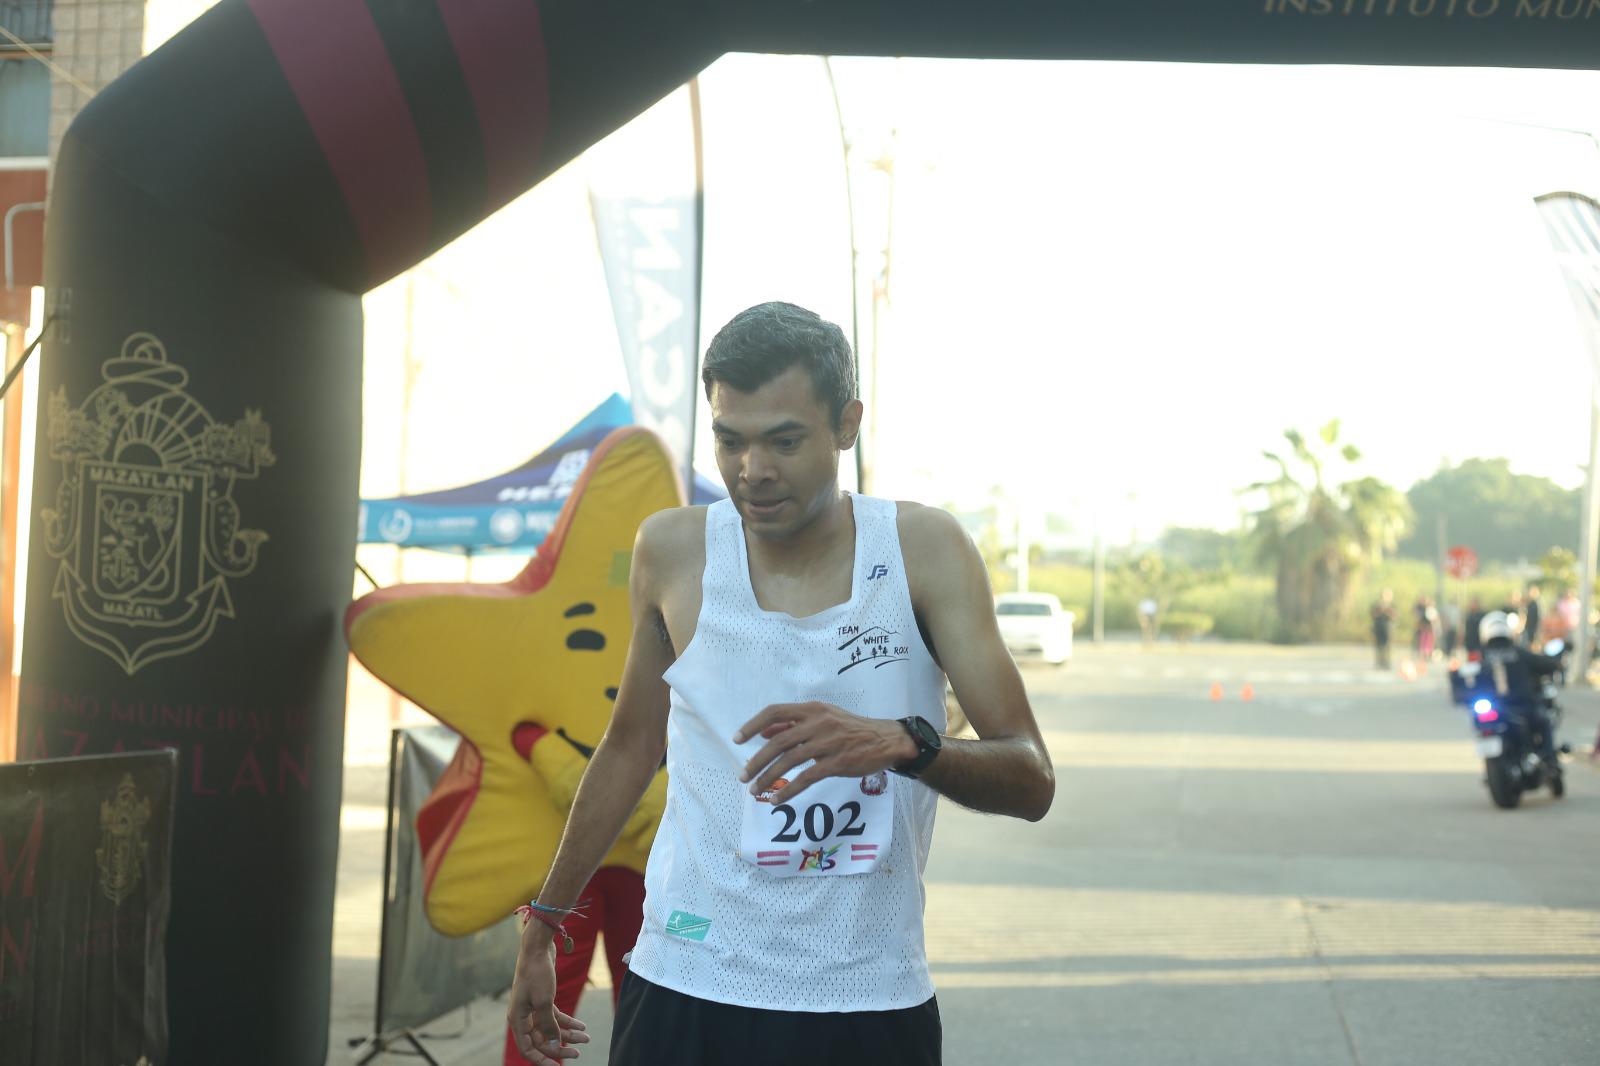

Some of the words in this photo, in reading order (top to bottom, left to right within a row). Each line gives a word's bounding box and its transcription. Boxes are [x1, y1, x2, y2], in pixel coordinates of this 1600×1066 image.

[90, 467, 194, 491] MAZATLAN
[863, 635, 890, 645] WHITE
[771, 801, 867, 843] 202
